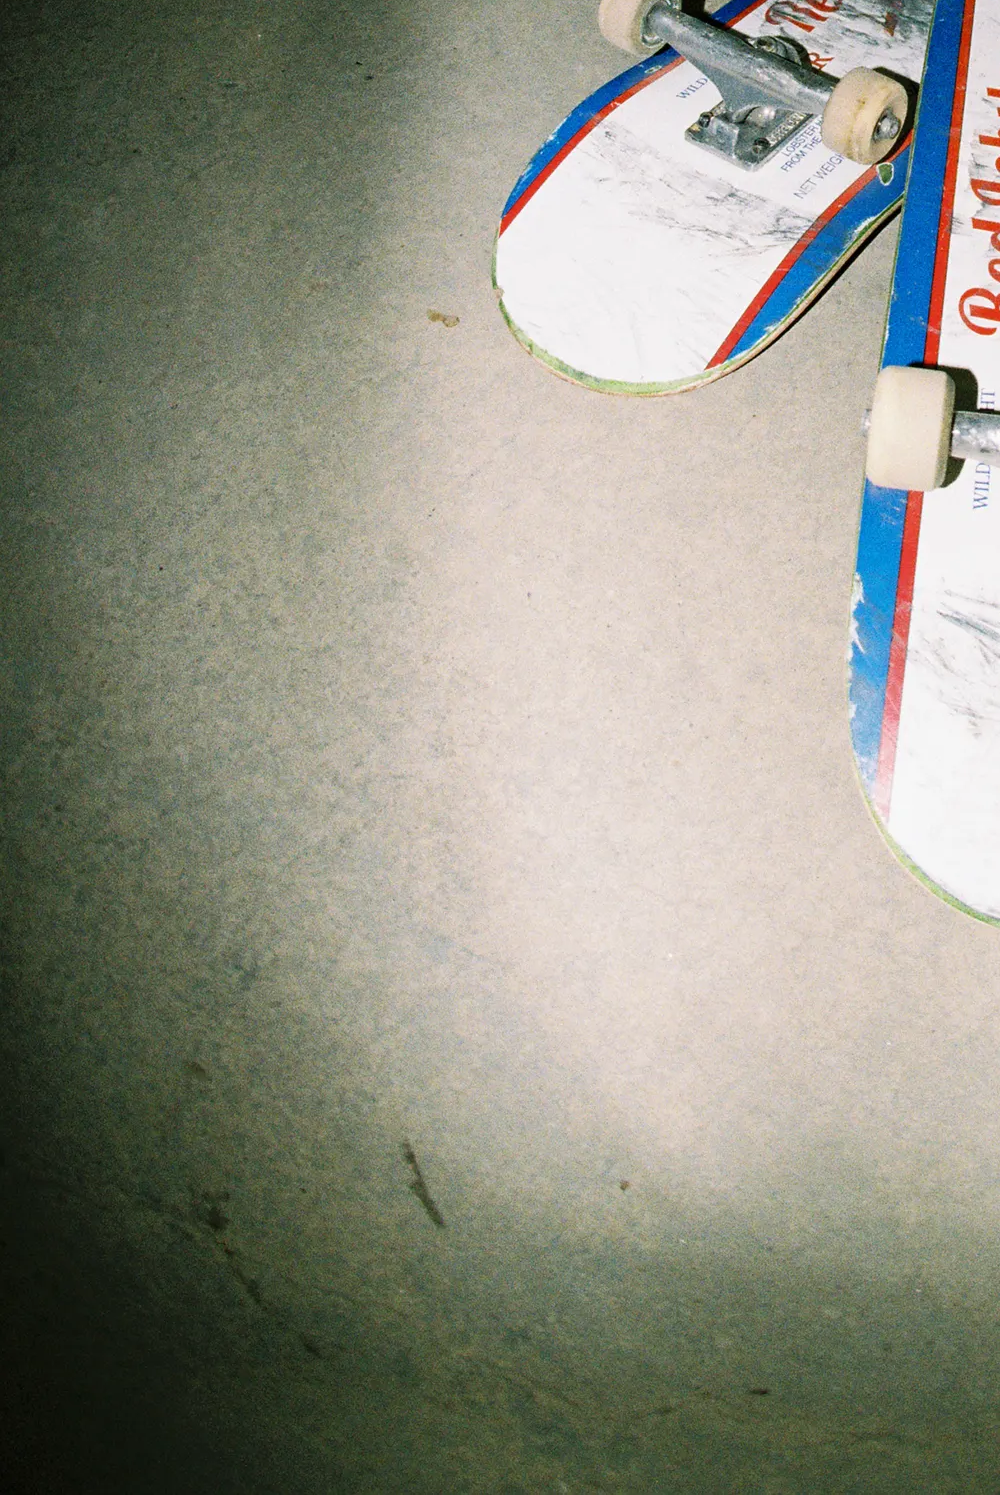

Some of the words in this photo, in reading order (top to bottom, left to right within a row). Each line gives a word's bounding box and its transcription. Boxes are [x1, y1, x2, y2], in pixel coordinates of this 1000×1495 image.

[676, 77, 709, 100] WILD
[780, 148, 808, 173] FROM
[802, 134, 822, 153] THE
[783, 122, 819, 157] LOBSTER
[793, 177, 818, 200] NET
[972, 462, 991, 511] WILD
